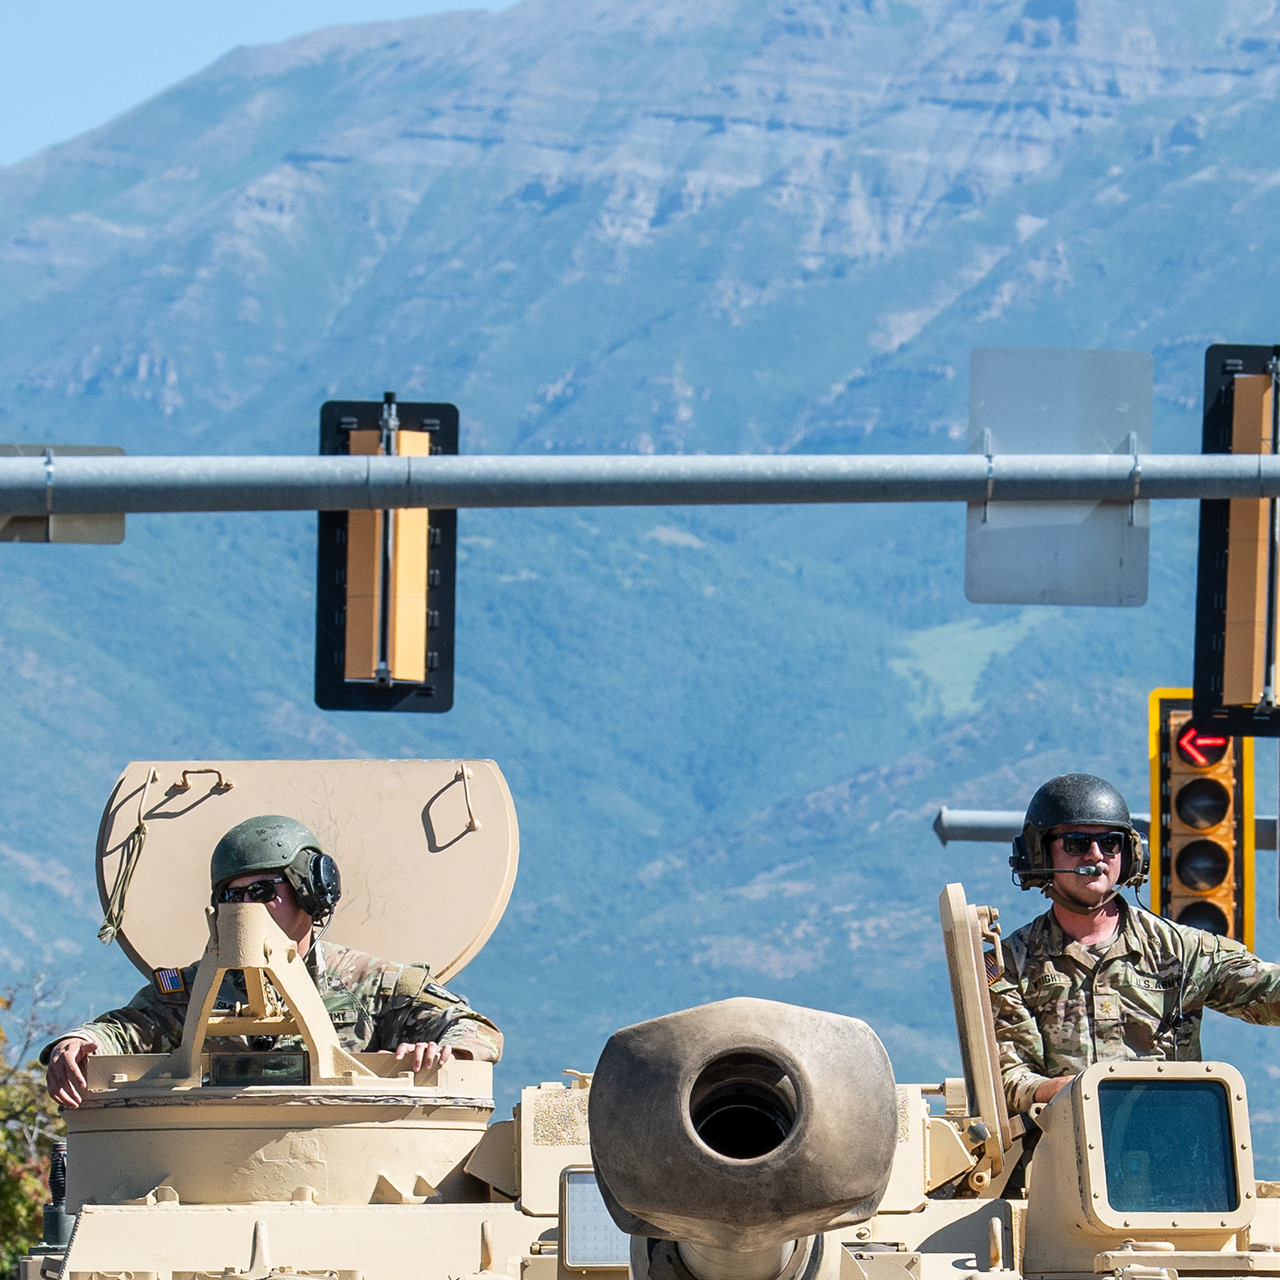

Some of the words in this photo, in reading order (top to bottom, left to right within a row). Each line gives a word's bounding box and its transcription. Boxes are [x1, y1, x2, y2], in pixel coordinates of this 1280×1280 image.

[1032, 972, 1062, 990] WRIGHT
[1135, 978, 1152, 988] U.S.
[1154, 977, 1181, 989] ARMY
